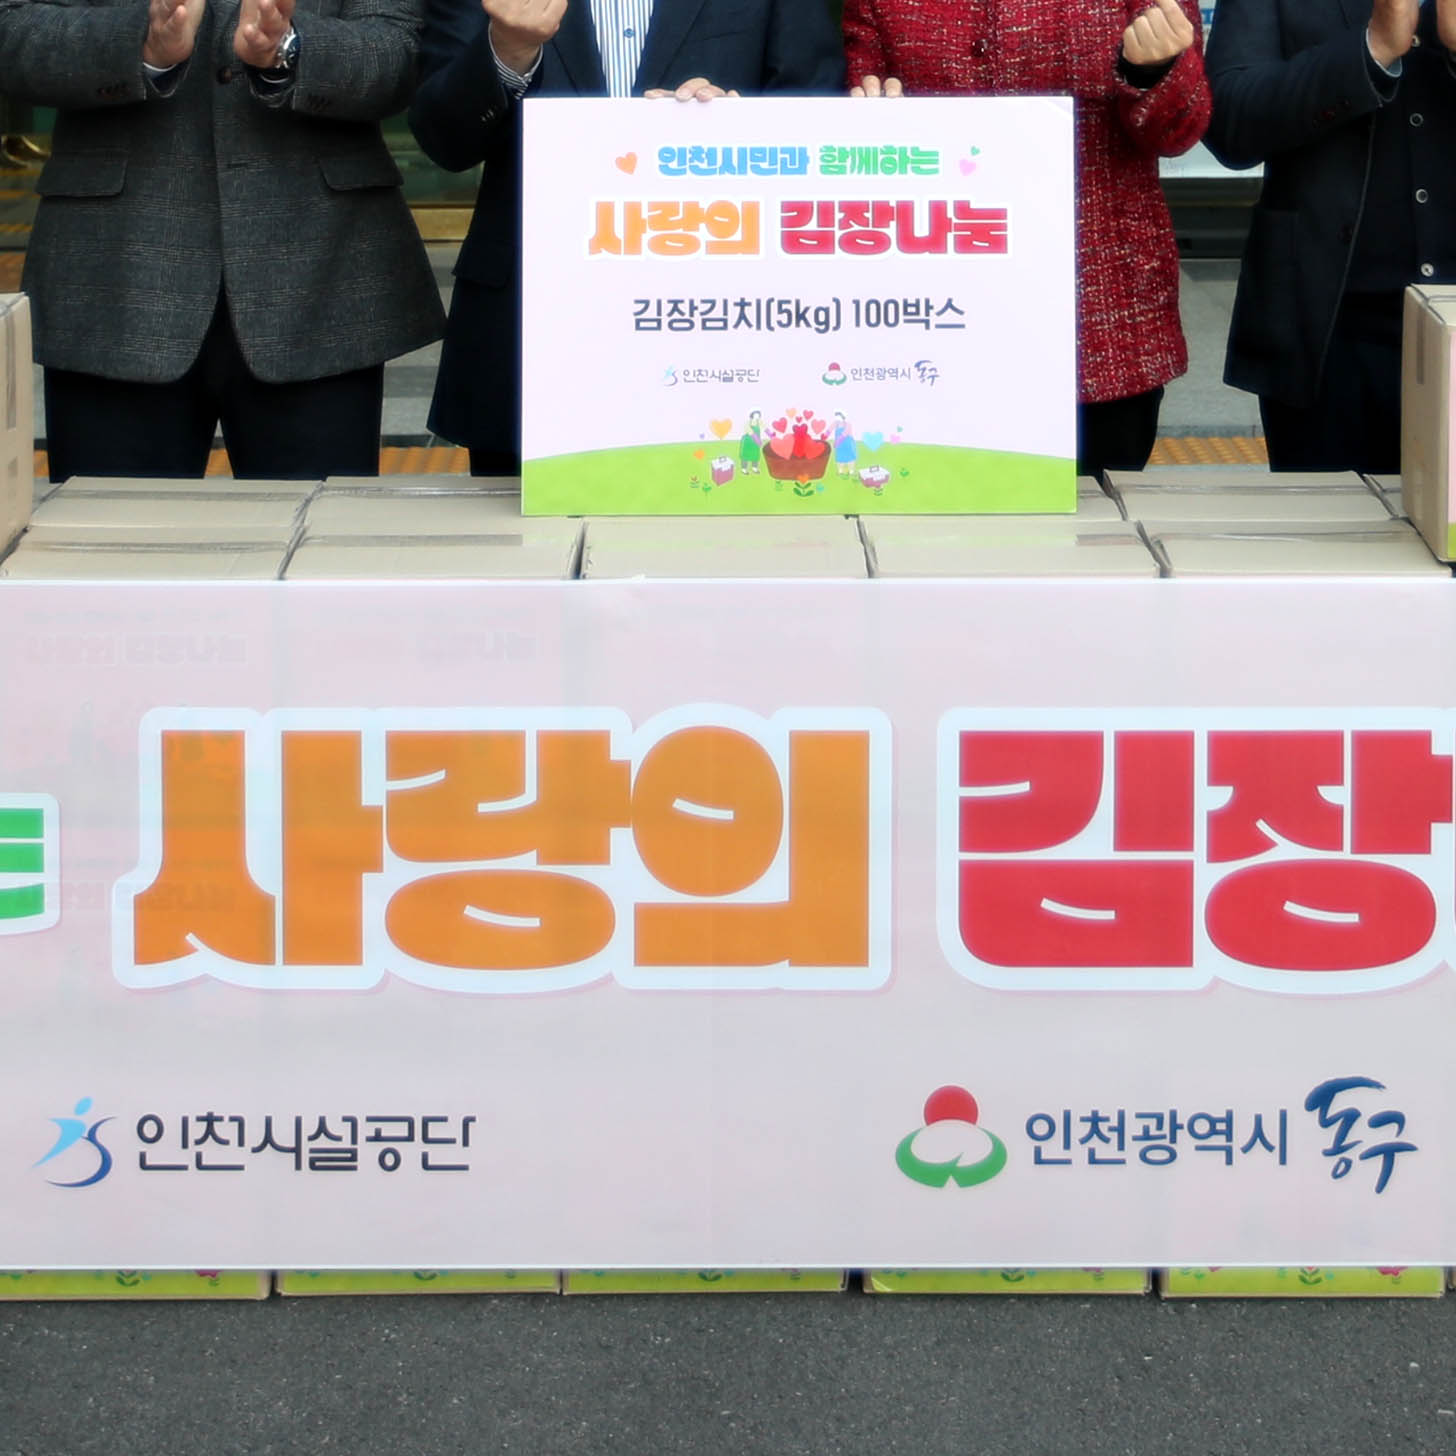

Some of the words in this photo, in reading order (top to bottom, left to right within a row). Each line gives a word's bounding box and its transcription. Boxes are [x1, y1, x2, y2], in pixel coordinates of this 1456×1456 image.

[659, 145, 810, 177] 인천시민과
[818, 145, 941, 176] 함께하는
[588, 200, 761, 255] 사랑의
[780, 199, 1008, 255] 김장나눔
[632, 296, 843, 335] 김장김치(5kg)
[852, 296, 966, 332] 100박스
[682, 367, 761, 384] 인천시설공단
[850, 366, 911, 382] 인천광역시
[914, 359, 940, 387] 동구
[132, 724, 871, 972] 사랑의
[135, 1111, 477, 1173] 인천시설공단
[1024, 1108, 1289, 1168] 인천광역시
[1302, 1075, 1420, 1196] 동구
